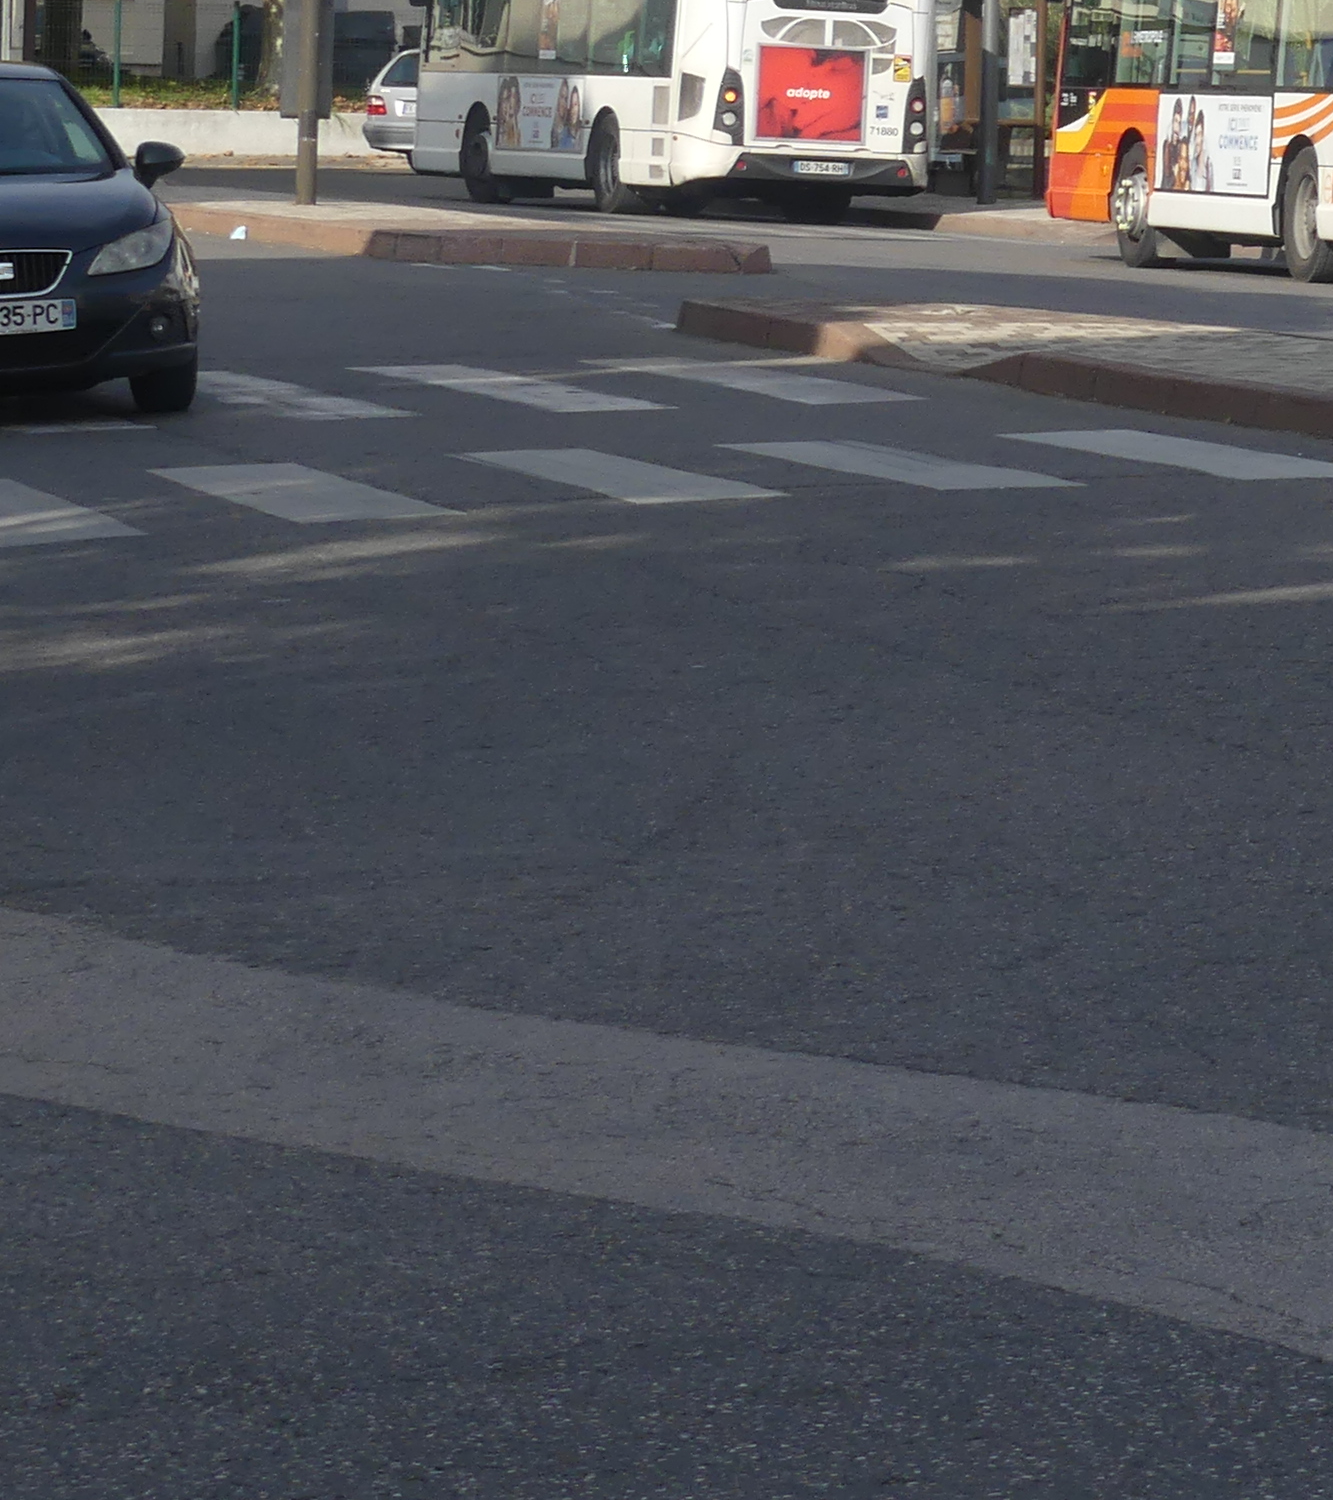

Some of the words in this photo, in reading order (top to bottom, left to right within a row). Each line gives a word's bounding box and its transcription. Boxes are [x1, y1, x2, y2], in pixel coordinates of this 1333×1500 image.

[786, 87, 831, 100] adopte
[869, 126, 899, 137] 71880
[1218, 135, 1259, 150] COMMENCE
